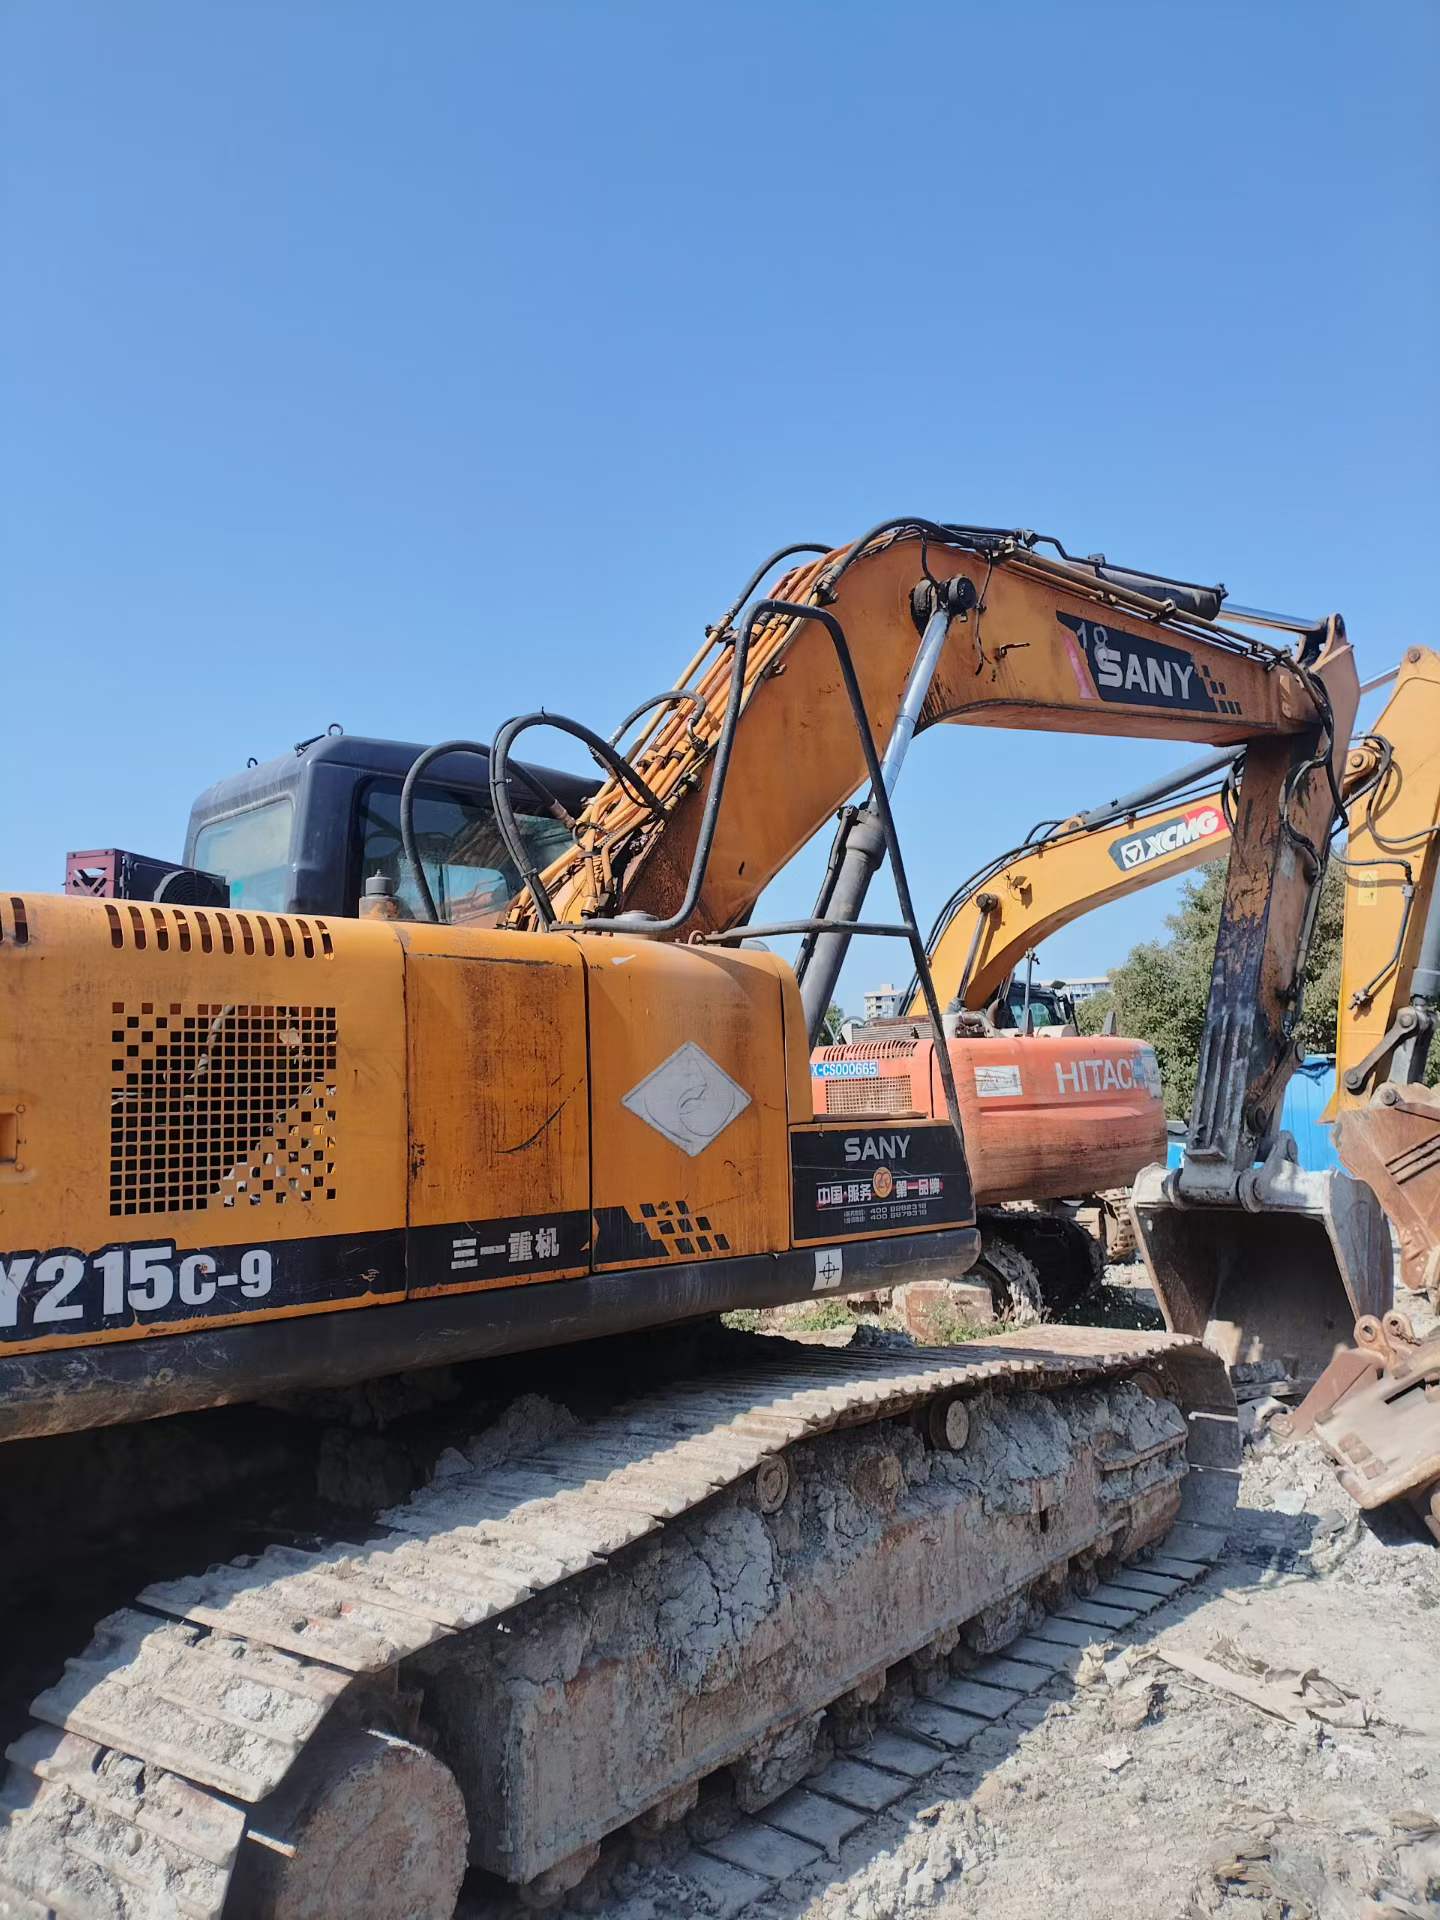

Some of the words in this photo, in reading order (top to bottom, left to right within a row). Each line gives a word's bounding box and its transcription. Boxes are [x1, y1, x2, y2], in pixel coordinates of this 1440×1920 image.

[1096, 648, 1194, 700] SANY
[1144, 811, 1219, 861] XCMG
[1054, 1058, 1150, 1094] HITAC
[844, 1135, 911, 1161] SANY
[896, 1177, 941, 1199] 第一品牌
[870, 1206, 888, 1215] 400
[870, 1213, 888, 1221] 400
[450, 1227, 560, 1270] 三一重机
